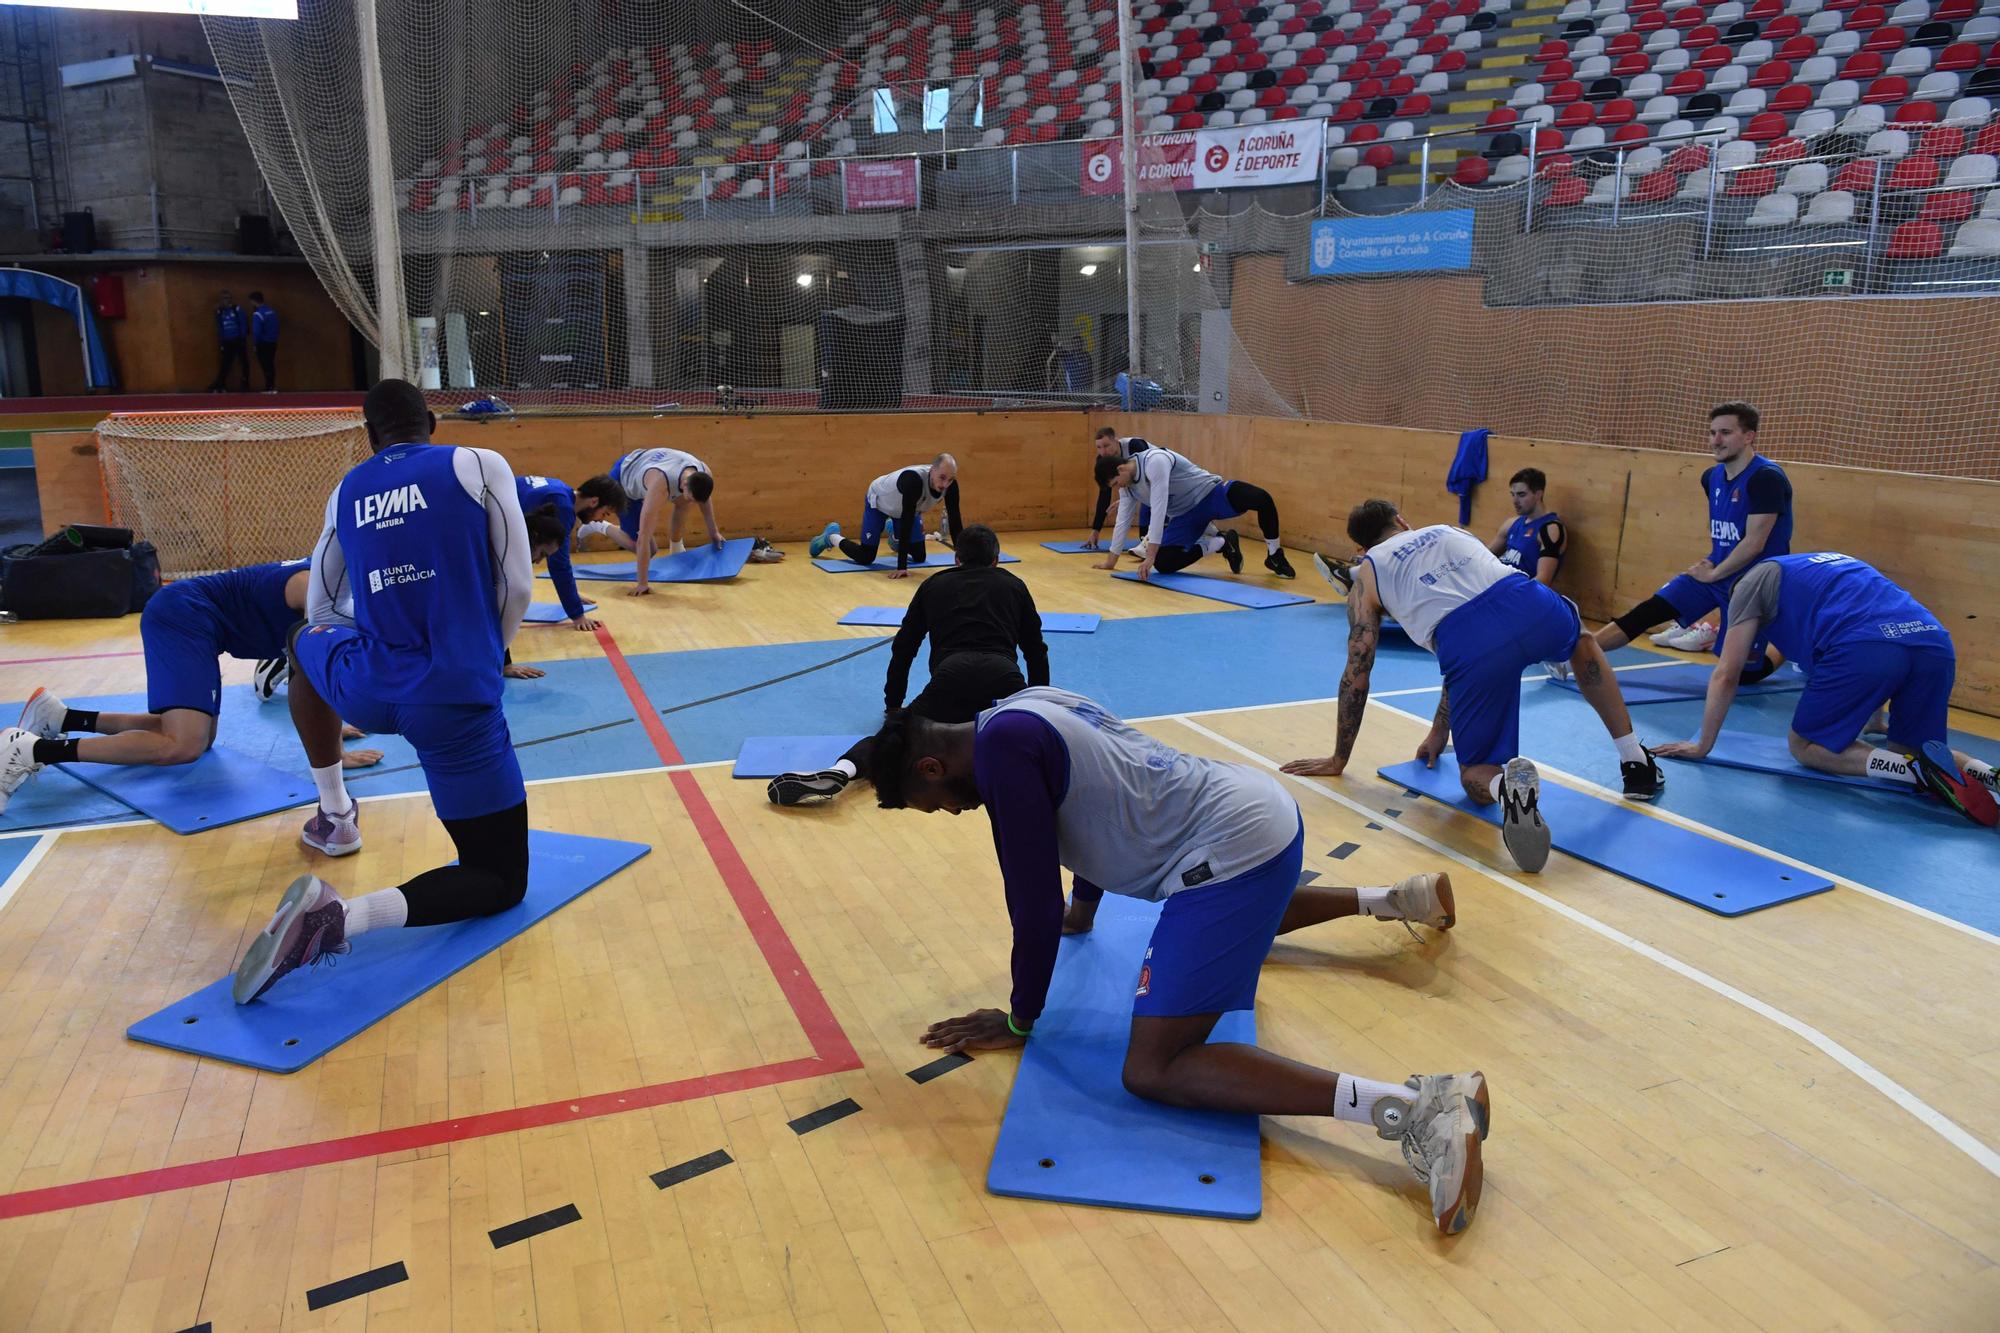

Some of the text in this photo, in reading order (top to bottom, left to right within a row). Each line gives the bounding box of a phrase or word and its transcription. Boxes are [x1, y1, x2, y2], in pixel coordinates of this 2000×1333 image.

[1237, 131, 1294, 154] A CORUÑA
[1244, 153, 1301, 171] DEPORTE
[1139, 165, 1147, 180] A
[1339, 229, 1469, 248] Ayuntamiento de A Coruña
[1339, 246, 1378, 258] Concello
[1381, 245, 1393, 256] da
[354, 483, 428, 528] LEYMA
[375, 517, 405, 530] NATURA
[1711, 518, 1740, 540] LEYMA
[382, 563, 416, 577] XUNTA
[384, 569, 437, 587] DE GALICIA
[1897, 620, 1923, 628] XUNTA
[1870, 758, 1906, 775] BRAND
